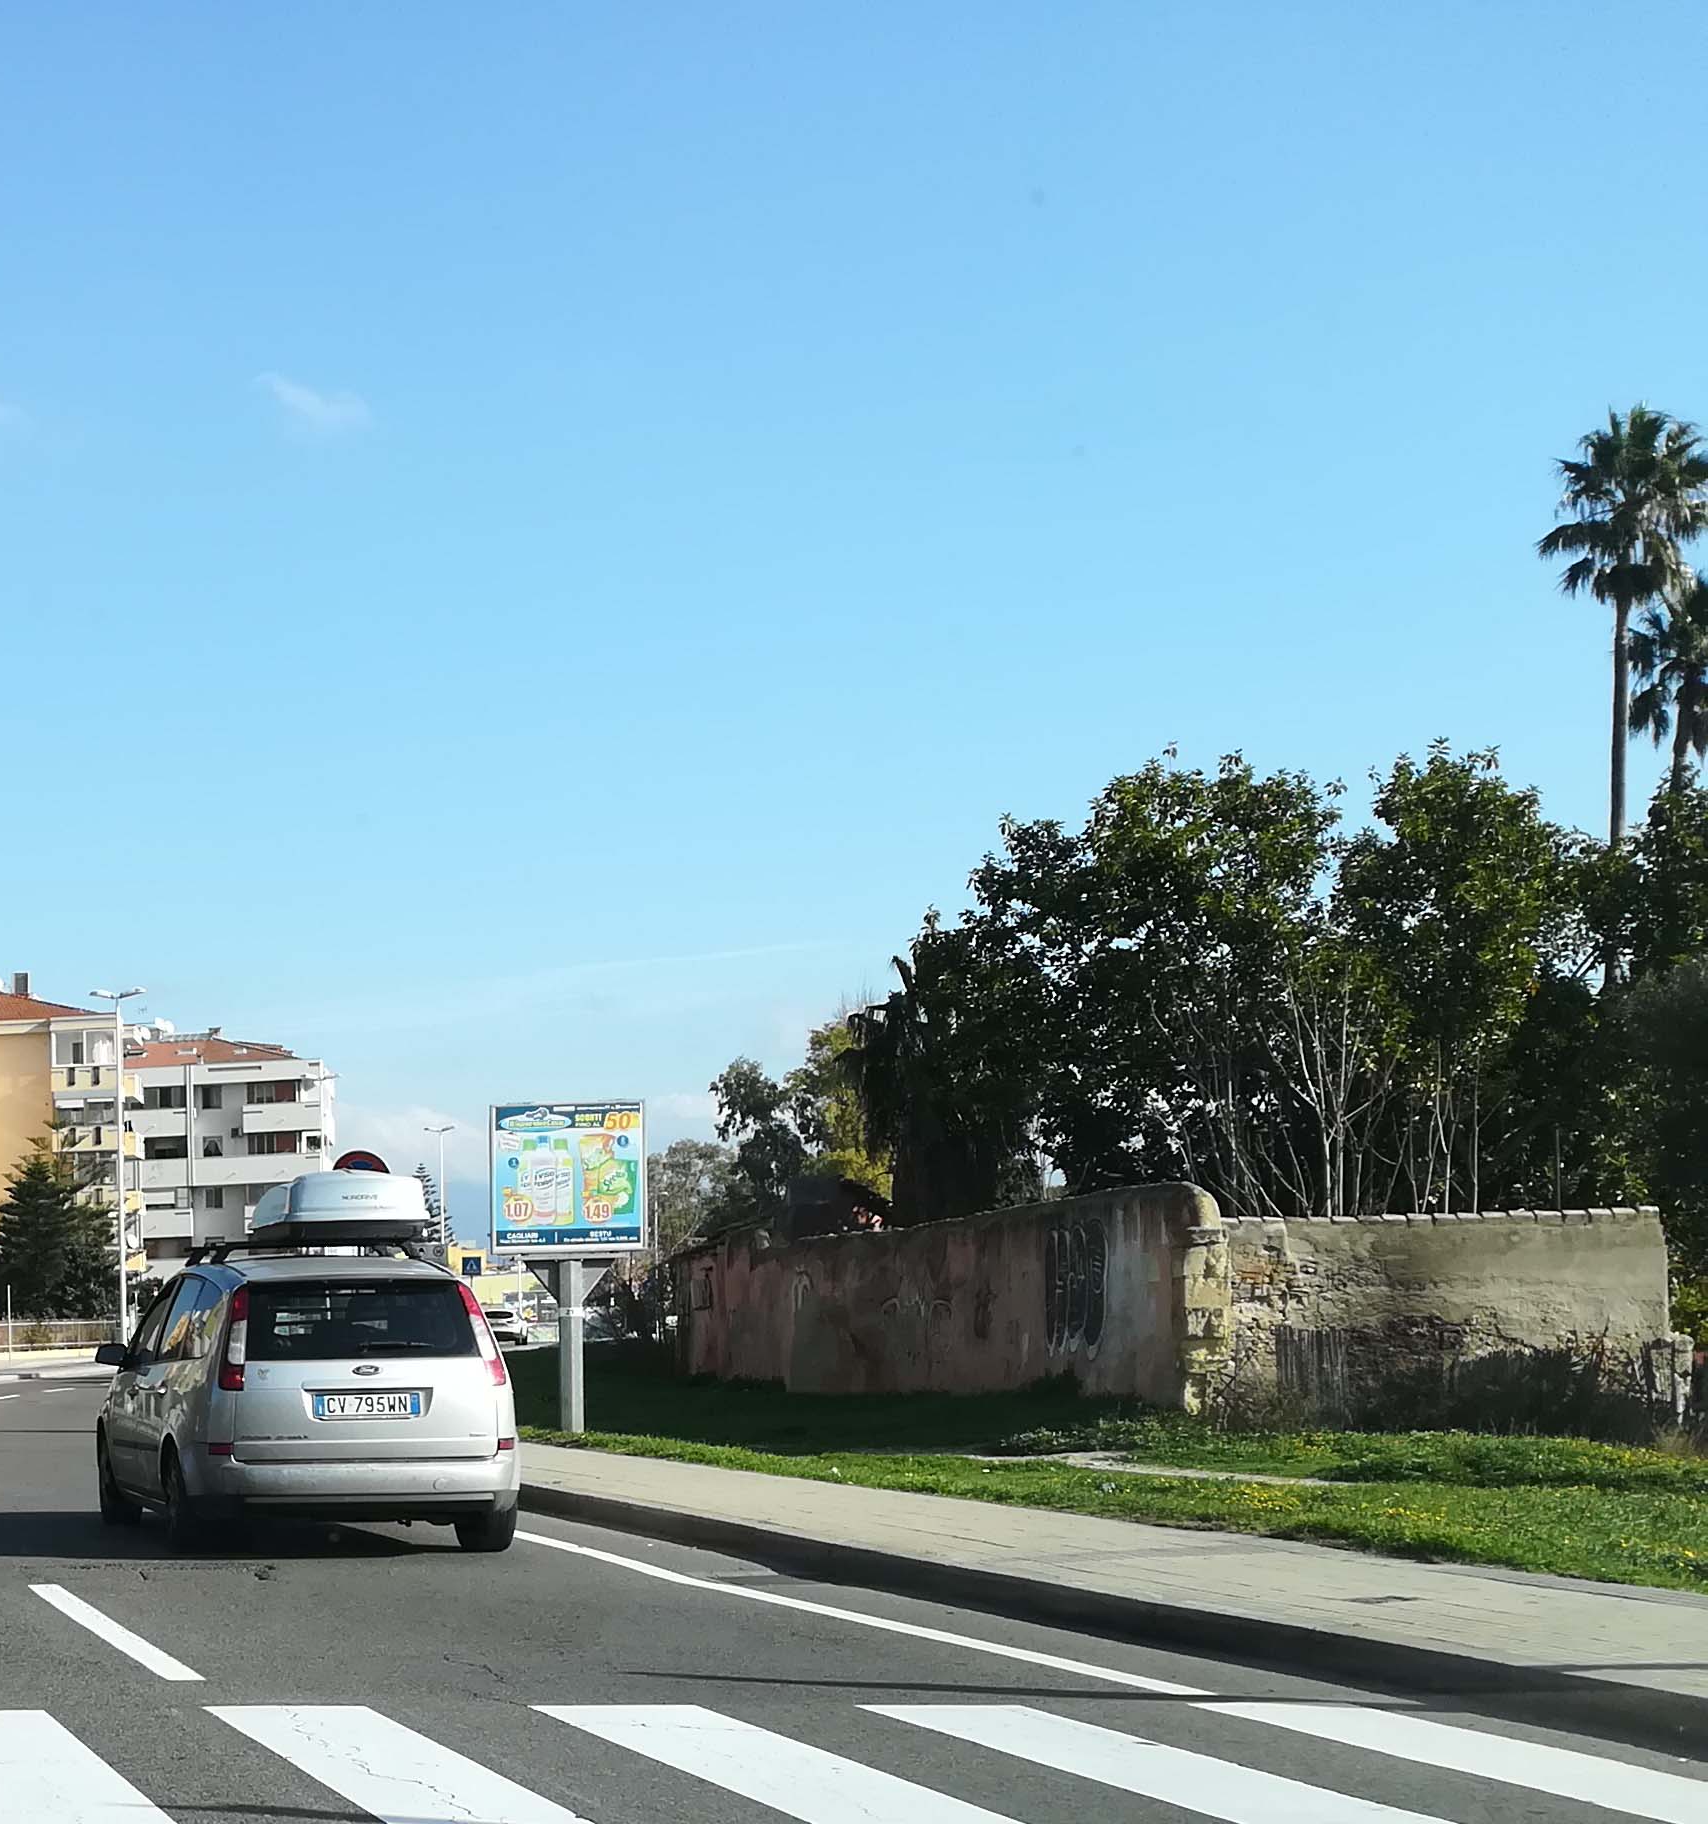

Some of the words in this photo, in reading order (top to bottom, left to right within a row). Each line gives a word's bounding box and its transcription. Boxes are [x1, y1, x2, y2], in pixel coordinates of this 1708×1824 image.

[505, 1202, 529, 1218] 1.07
[584, 1203, 610, 1220] 1.49
[506, 1232, 539, 1240] CAGLIARI
[326, 1397, 347, 1414] CV
[354, 1395, 408, 1413] 795WN
